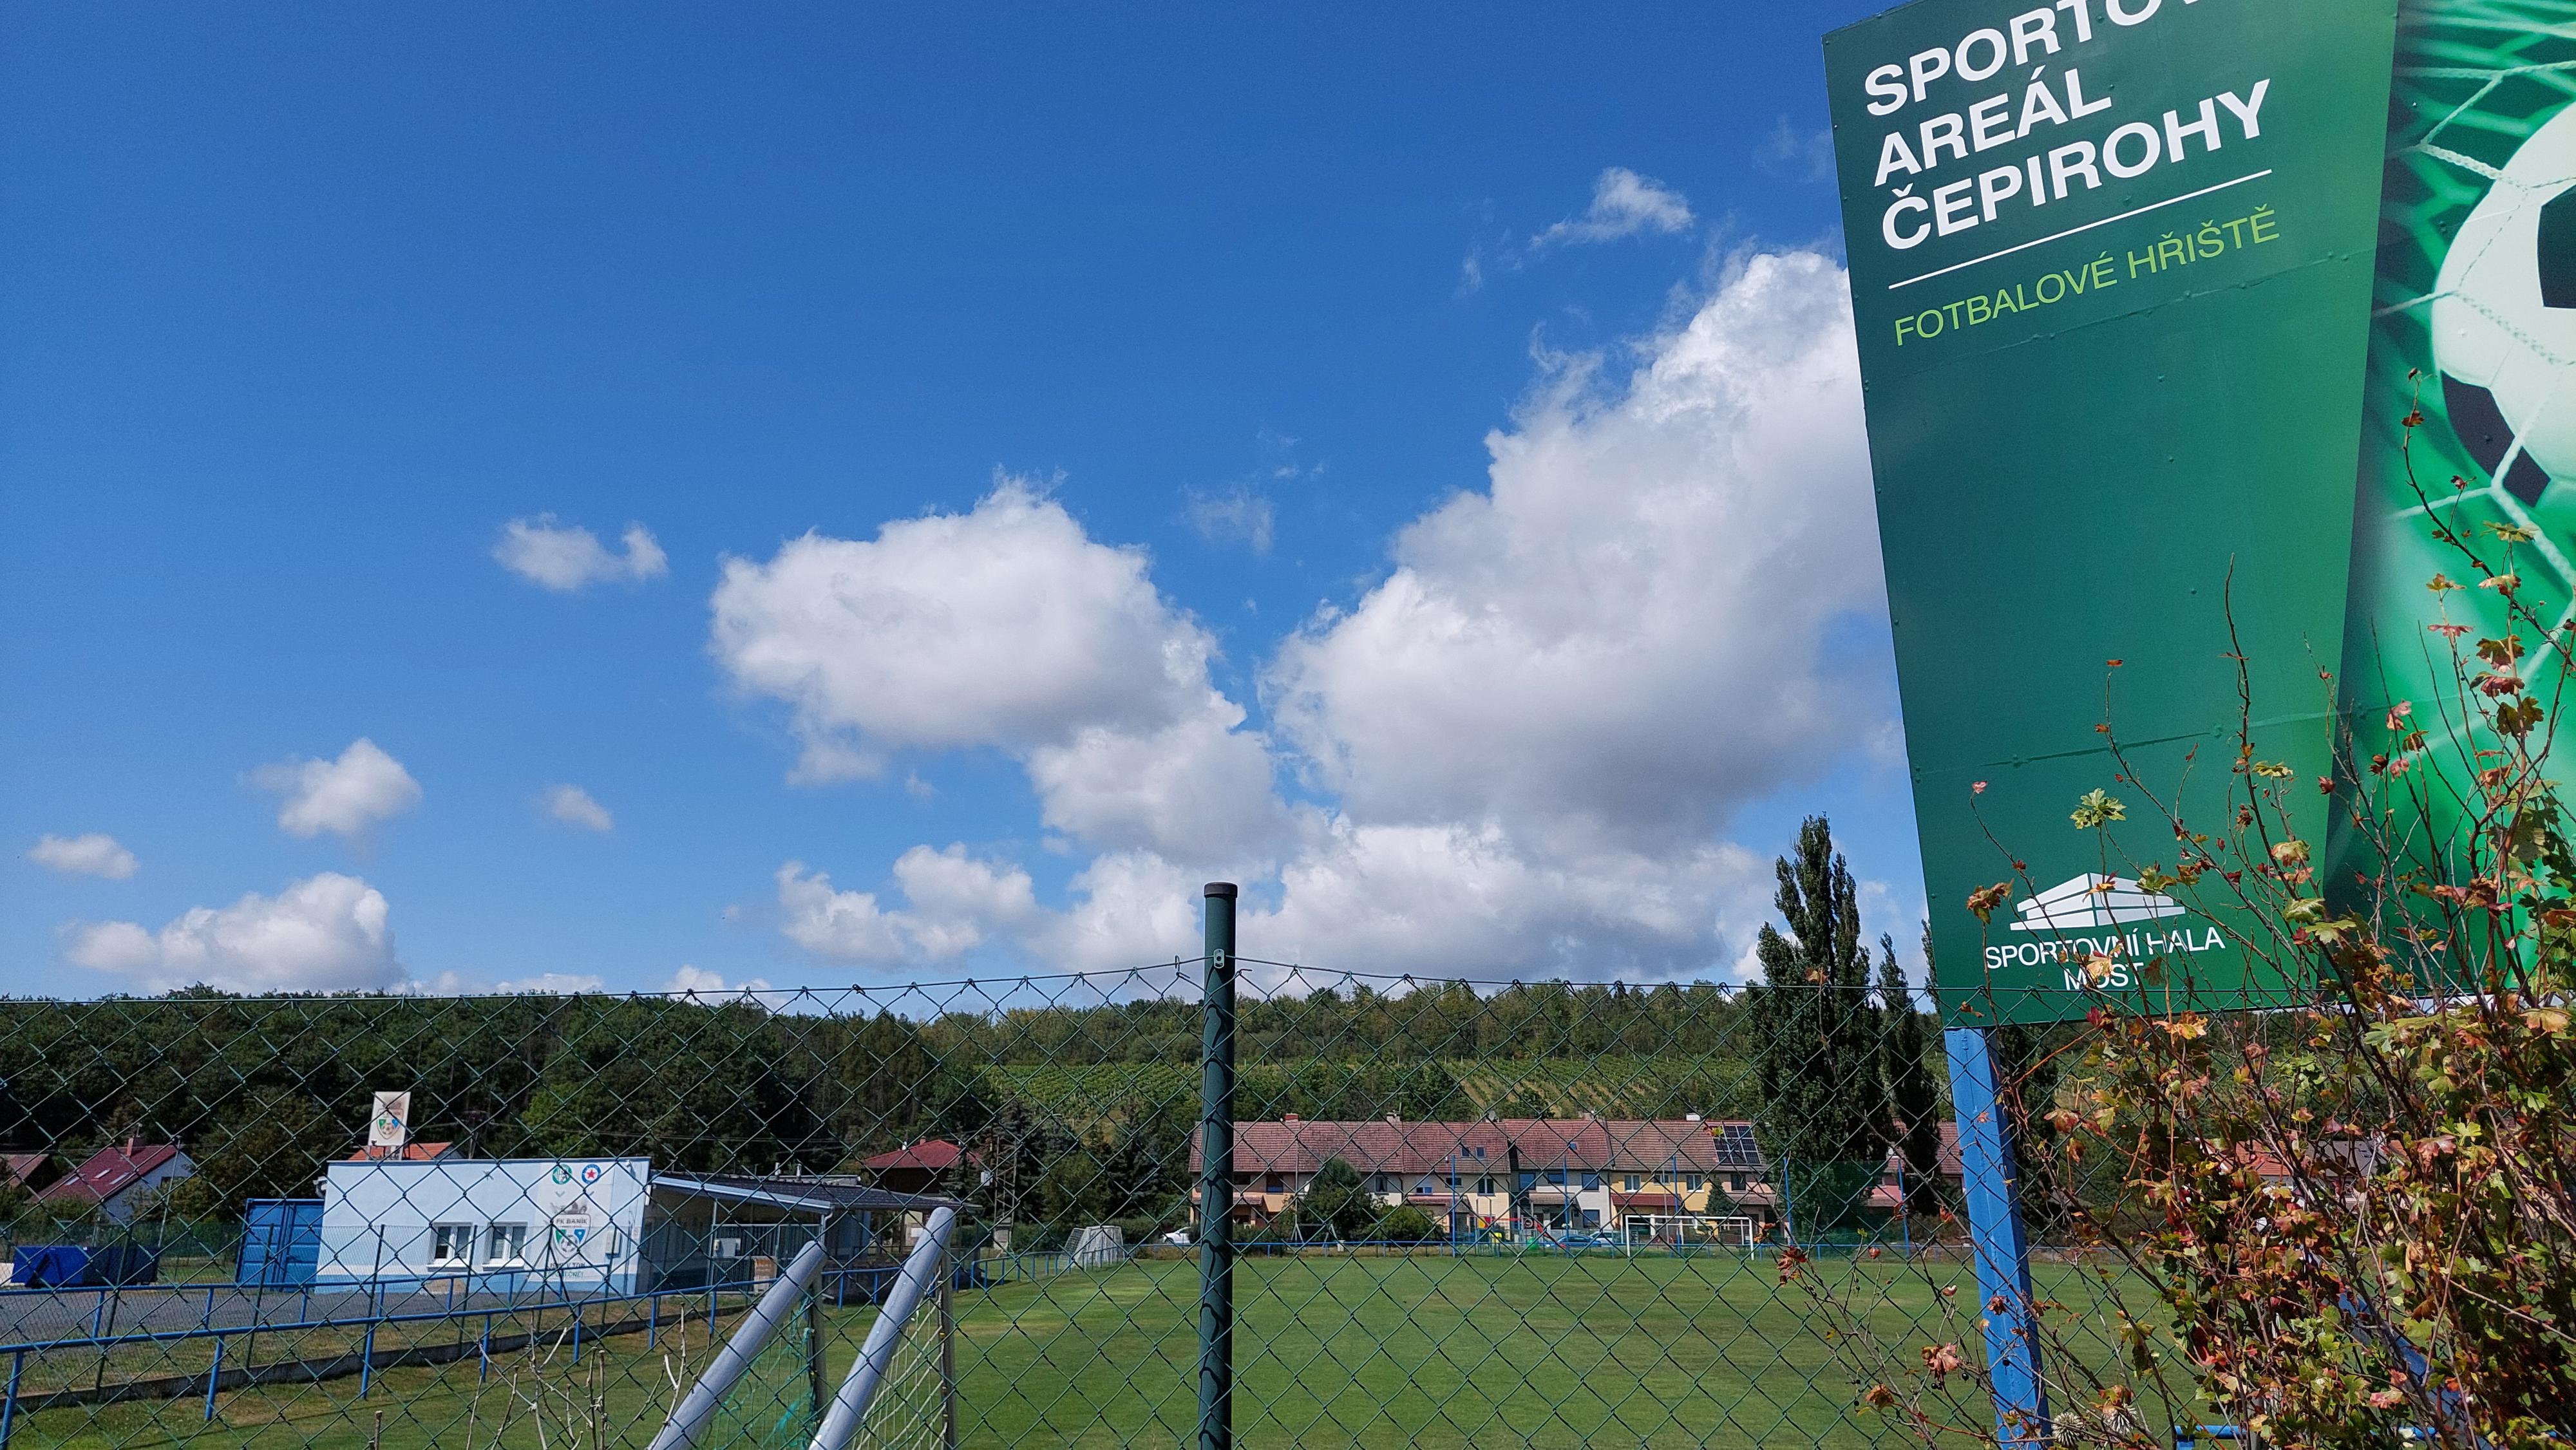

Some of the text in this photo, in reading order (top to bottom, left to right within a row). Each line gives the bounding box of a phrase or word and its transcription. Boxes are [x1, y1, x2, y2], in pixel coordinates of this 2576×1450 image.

[1864, 0, 2199, 117] SPORTO
[1874, 65, 2112, 187] AREÁL
[1882, 78, 2271, 250] ČEPIROHY
[1894, 203, 2280, 346] FOTBALOVÉ HŘIŠTĚ
[2146, 927, 2226, 955] HALA
